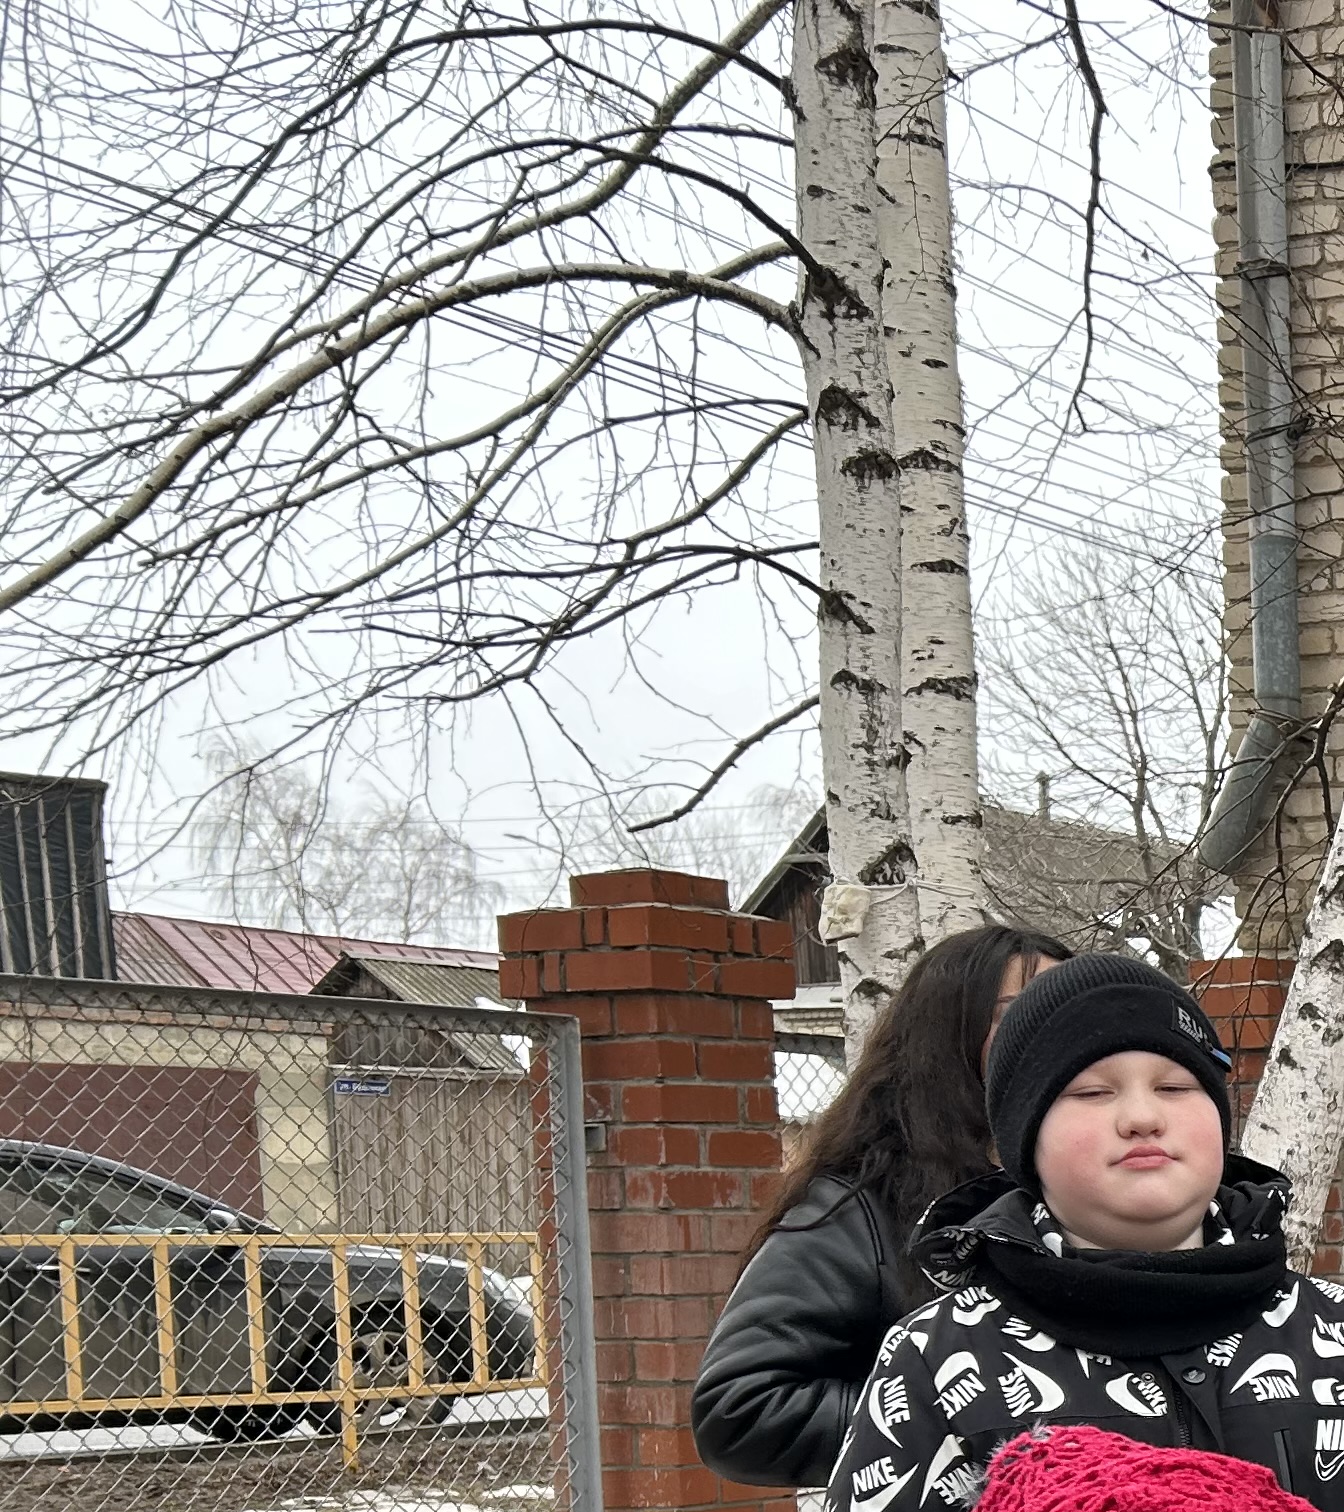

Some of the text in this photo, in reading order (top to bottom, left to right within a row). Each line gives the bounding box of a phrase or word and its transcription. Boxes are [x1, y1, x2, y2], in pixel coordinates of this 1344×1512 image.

[954, 1285, 994, 1308] NIK
[884, 1375, 910, 1428] NIKE
[934, 1372, 986, 1420] NIKE
[998, 1367, 1035, 1418] NIKE
[1250, 1375, 1300, 1402] NIKE
[852, 1456, 899, 1495] NIKE
